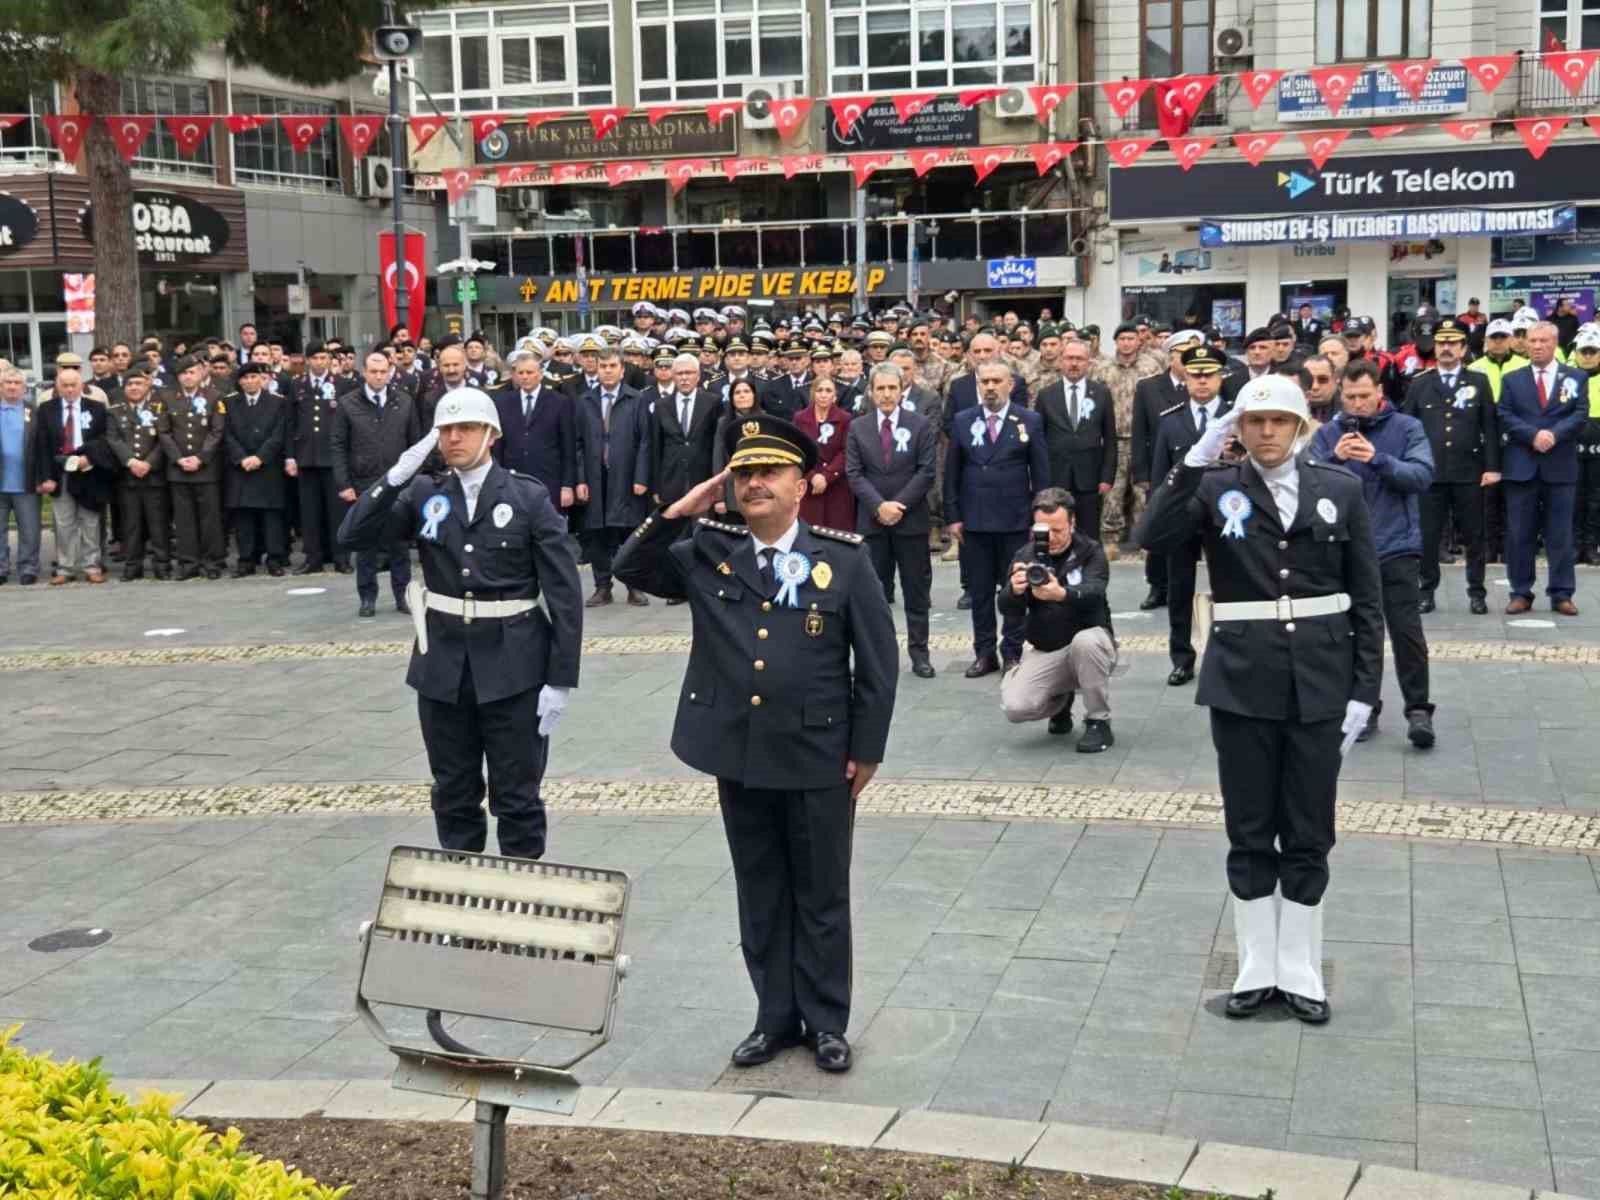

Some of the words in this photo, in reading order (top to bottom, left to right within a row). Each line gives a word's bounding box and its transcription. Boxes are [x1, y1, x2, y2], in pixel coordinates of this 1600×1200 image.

[567, 121, 625, 141] MEAL
[1320, 171, 1384, 196] Türk
[1391, 167, 1515, 193] Telekom
[1220, 219, 1287, 243] SINIRSIZ
[1289, 215, 1329, 242] EV-İŞ
[1332, 213, 1404, 238] İNTERNET
[1406, 211, 1482, 238] BAŞVURU
[1485, 208, 1554, 232] NOKTASI
[135, 232, 211, 254] staurant
[546, 278, 605, 303] ANT
[611, 275, 692, 300] TERME
[699, 270, 755, 298] PİDE
[761, 272, 795, 296] VE
